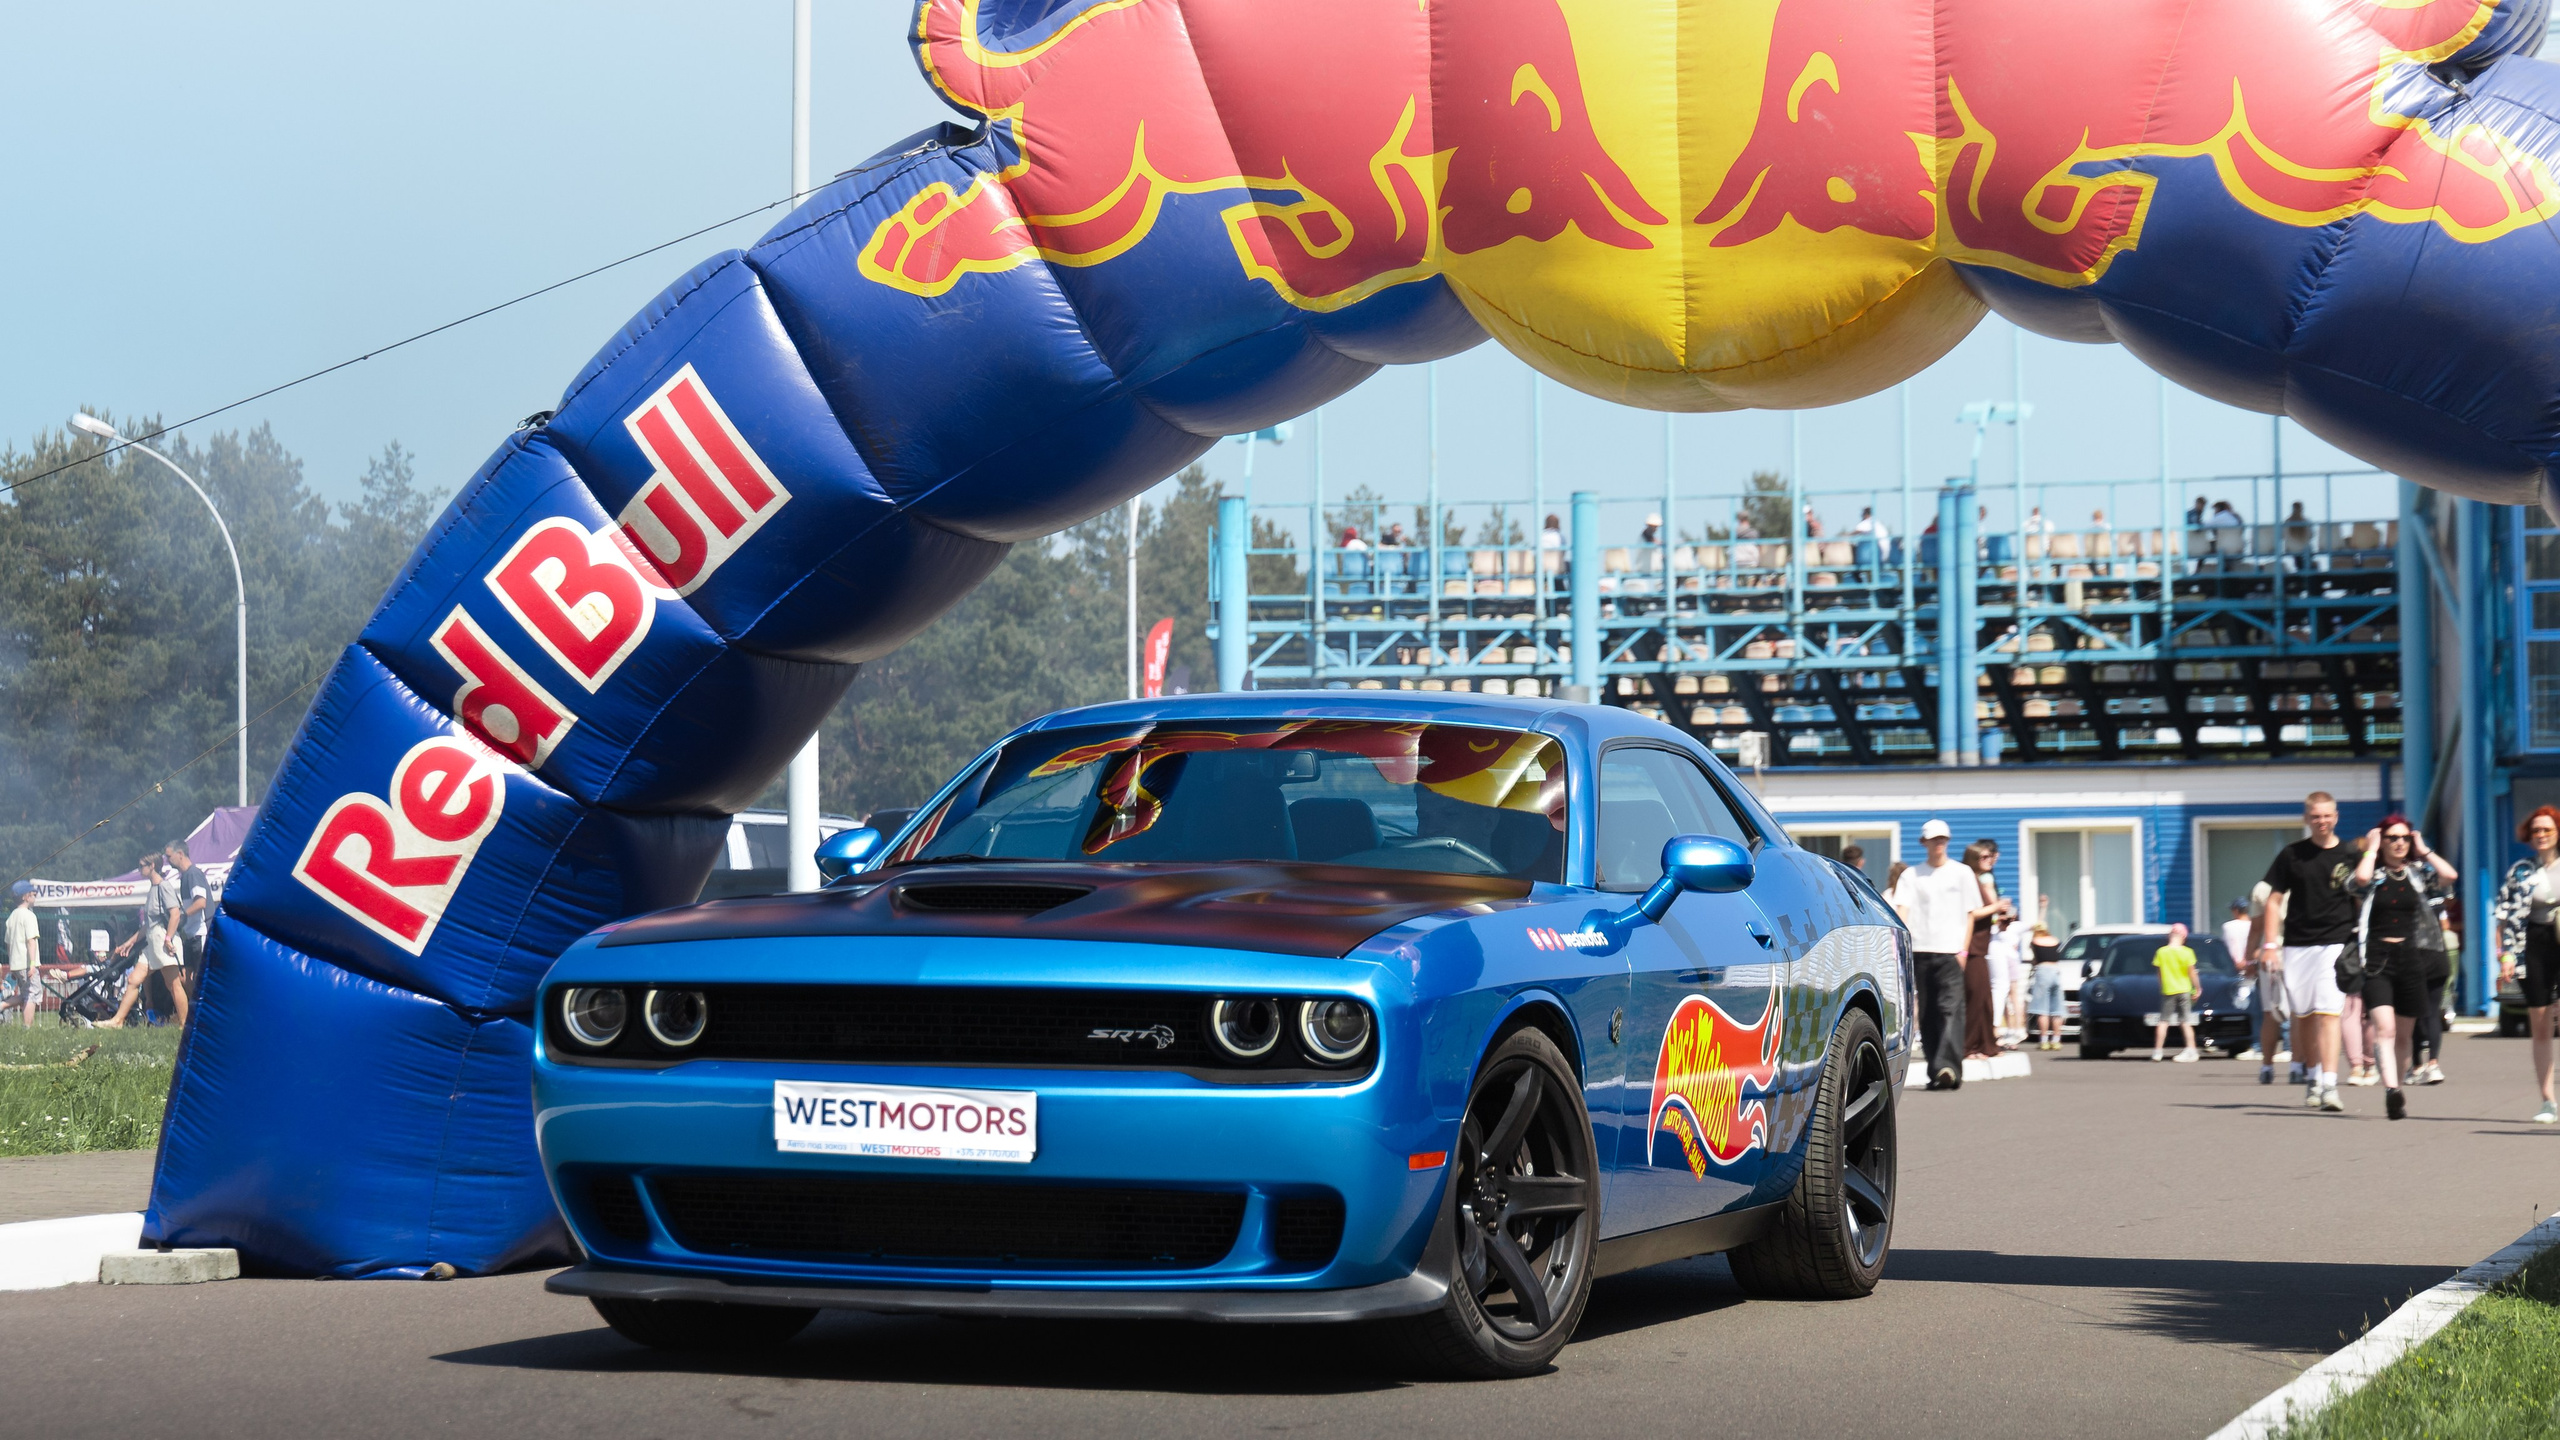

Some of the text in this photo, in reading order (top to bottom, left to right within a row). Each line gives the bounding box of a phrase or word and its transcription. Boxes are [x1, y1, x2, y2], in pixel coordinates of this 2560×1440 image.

[303, 376, 777, 943] Red Bull
[35, 883, 136, 898] WESTMOTORS
[1086, 1029, 1157, 1043] SRT
[783, 1095, 1027, 1137] WESTMOTORS
[1663, 1109, 1682, 1132] АВТО
[1679, 1119, 1694, 1153] ПОД
[860, 1143, 941, 1157] WESTMOTORS
